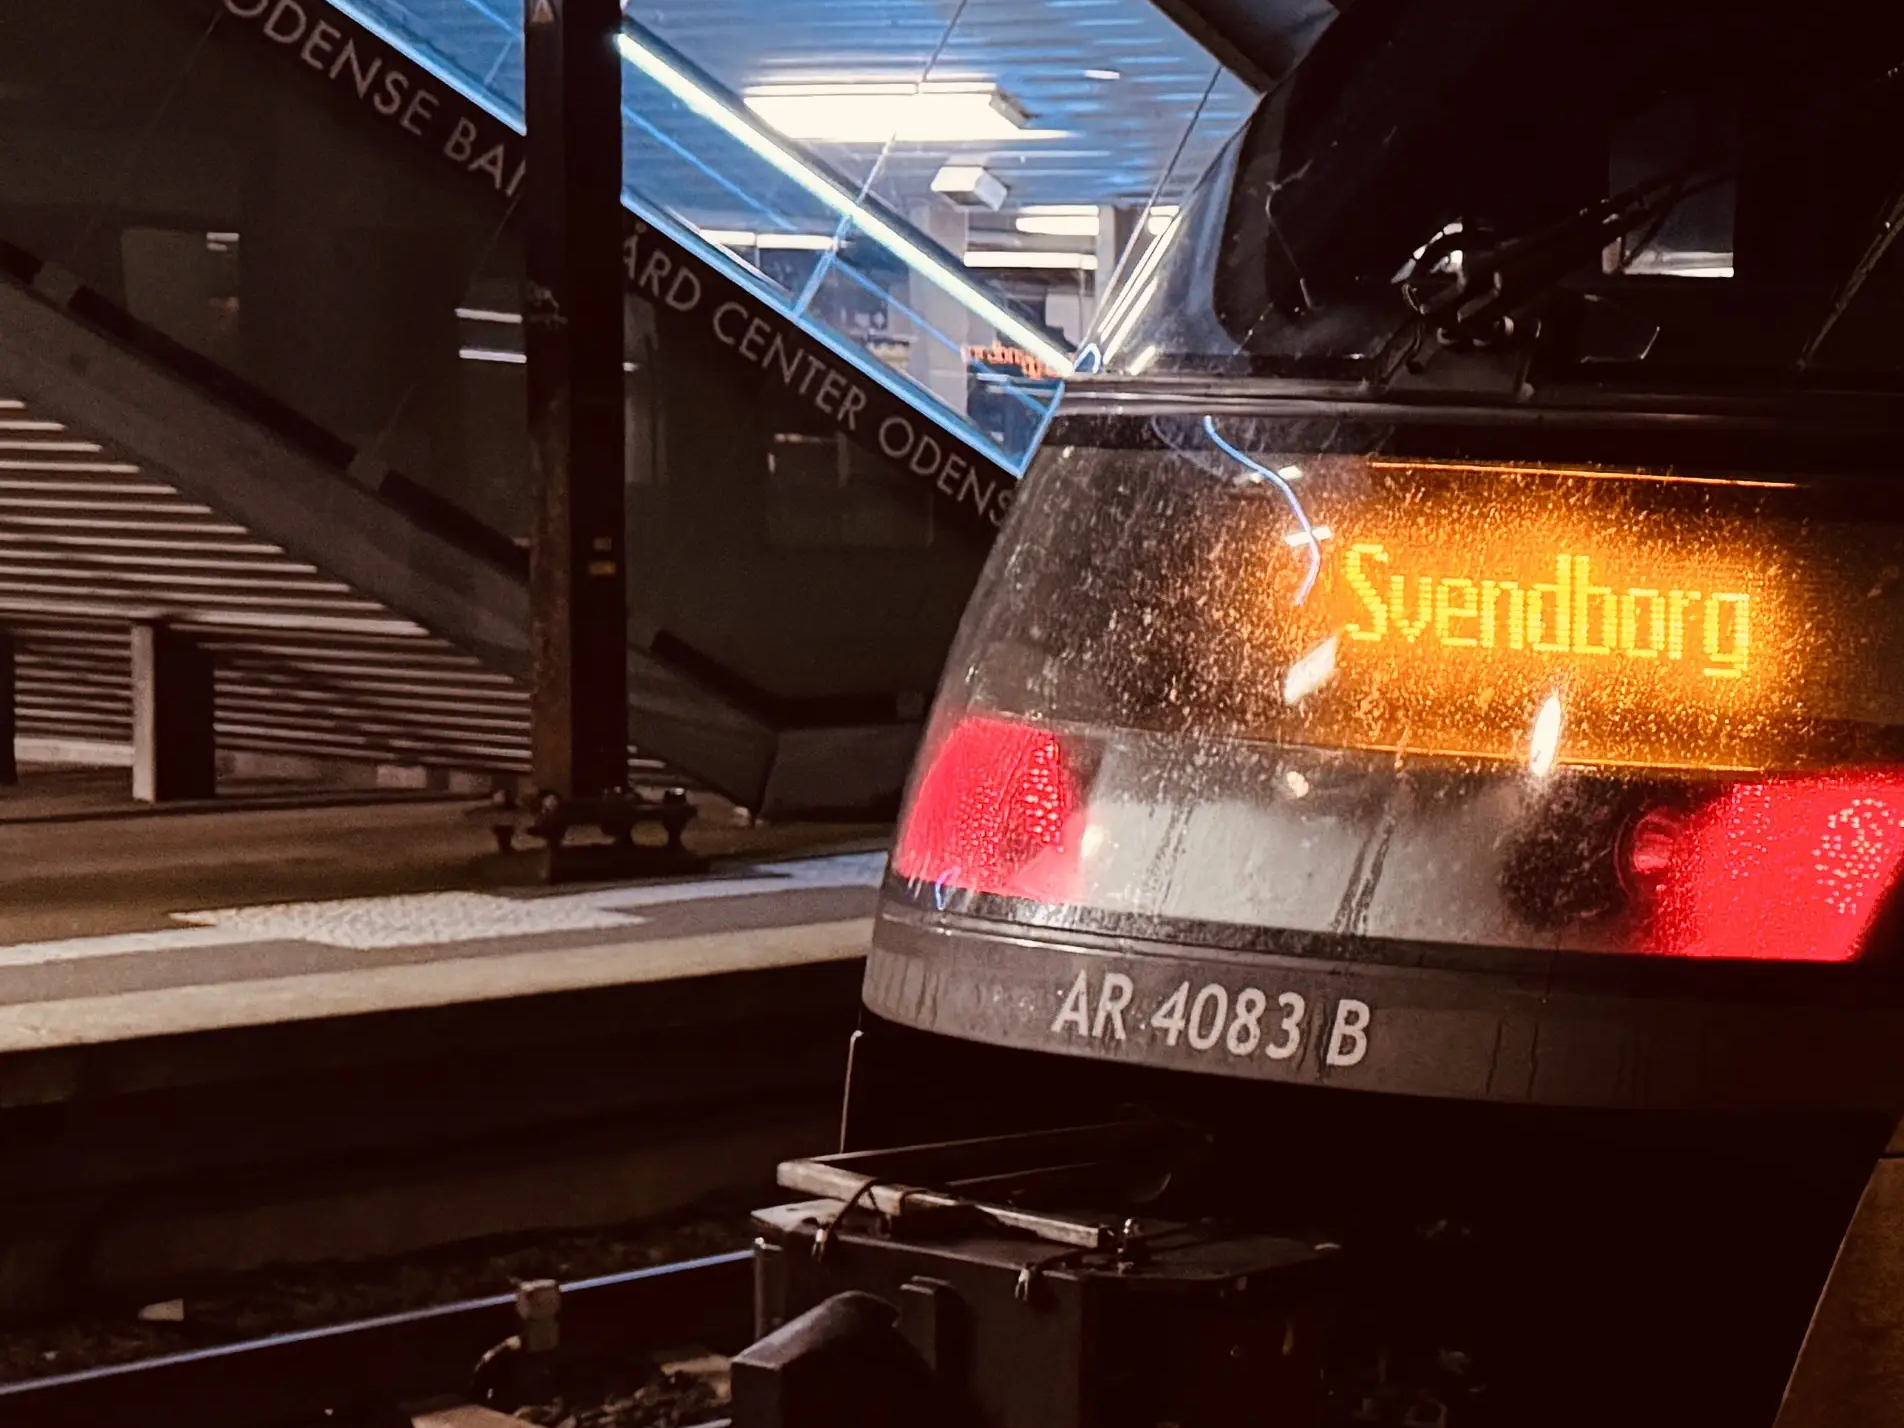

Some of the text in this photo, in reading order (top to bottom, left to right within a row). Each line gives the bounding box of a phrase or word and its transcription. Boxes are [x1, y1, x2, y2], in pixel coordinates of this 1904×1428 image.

[712, 301, 868, 431] CENTER
[1344, 543, 1750, 678] Svendborg
[1051, 969, 1371, 1067] AR 4083 B
